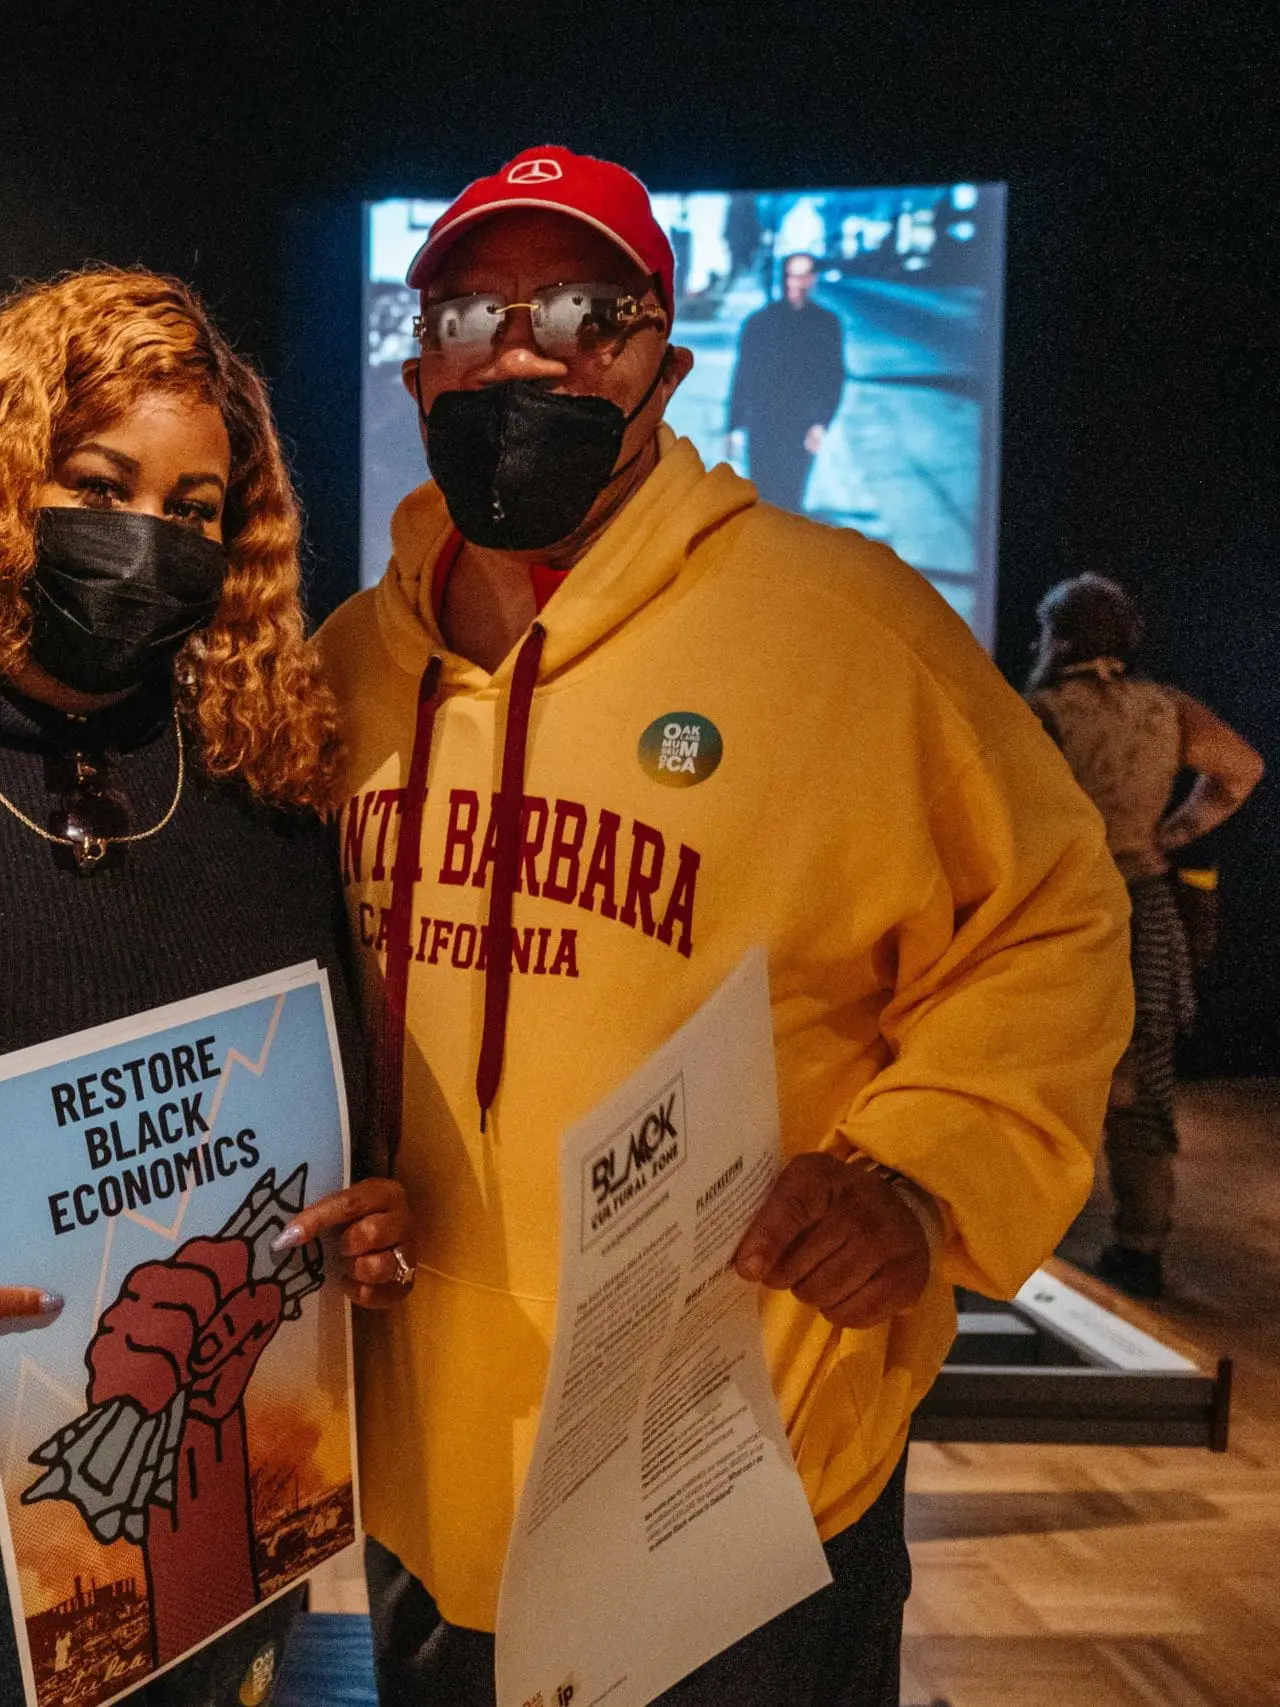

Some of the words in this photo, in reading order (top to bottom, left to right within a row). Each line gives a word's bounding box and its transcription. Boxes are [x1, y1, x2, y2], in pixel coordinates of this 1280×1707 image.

[51, 1035, 222, 1128] RESTORE
[84, 1091, 211, 1171] BLACK
[47, 1127, 261, 1236] ECONOMICS
